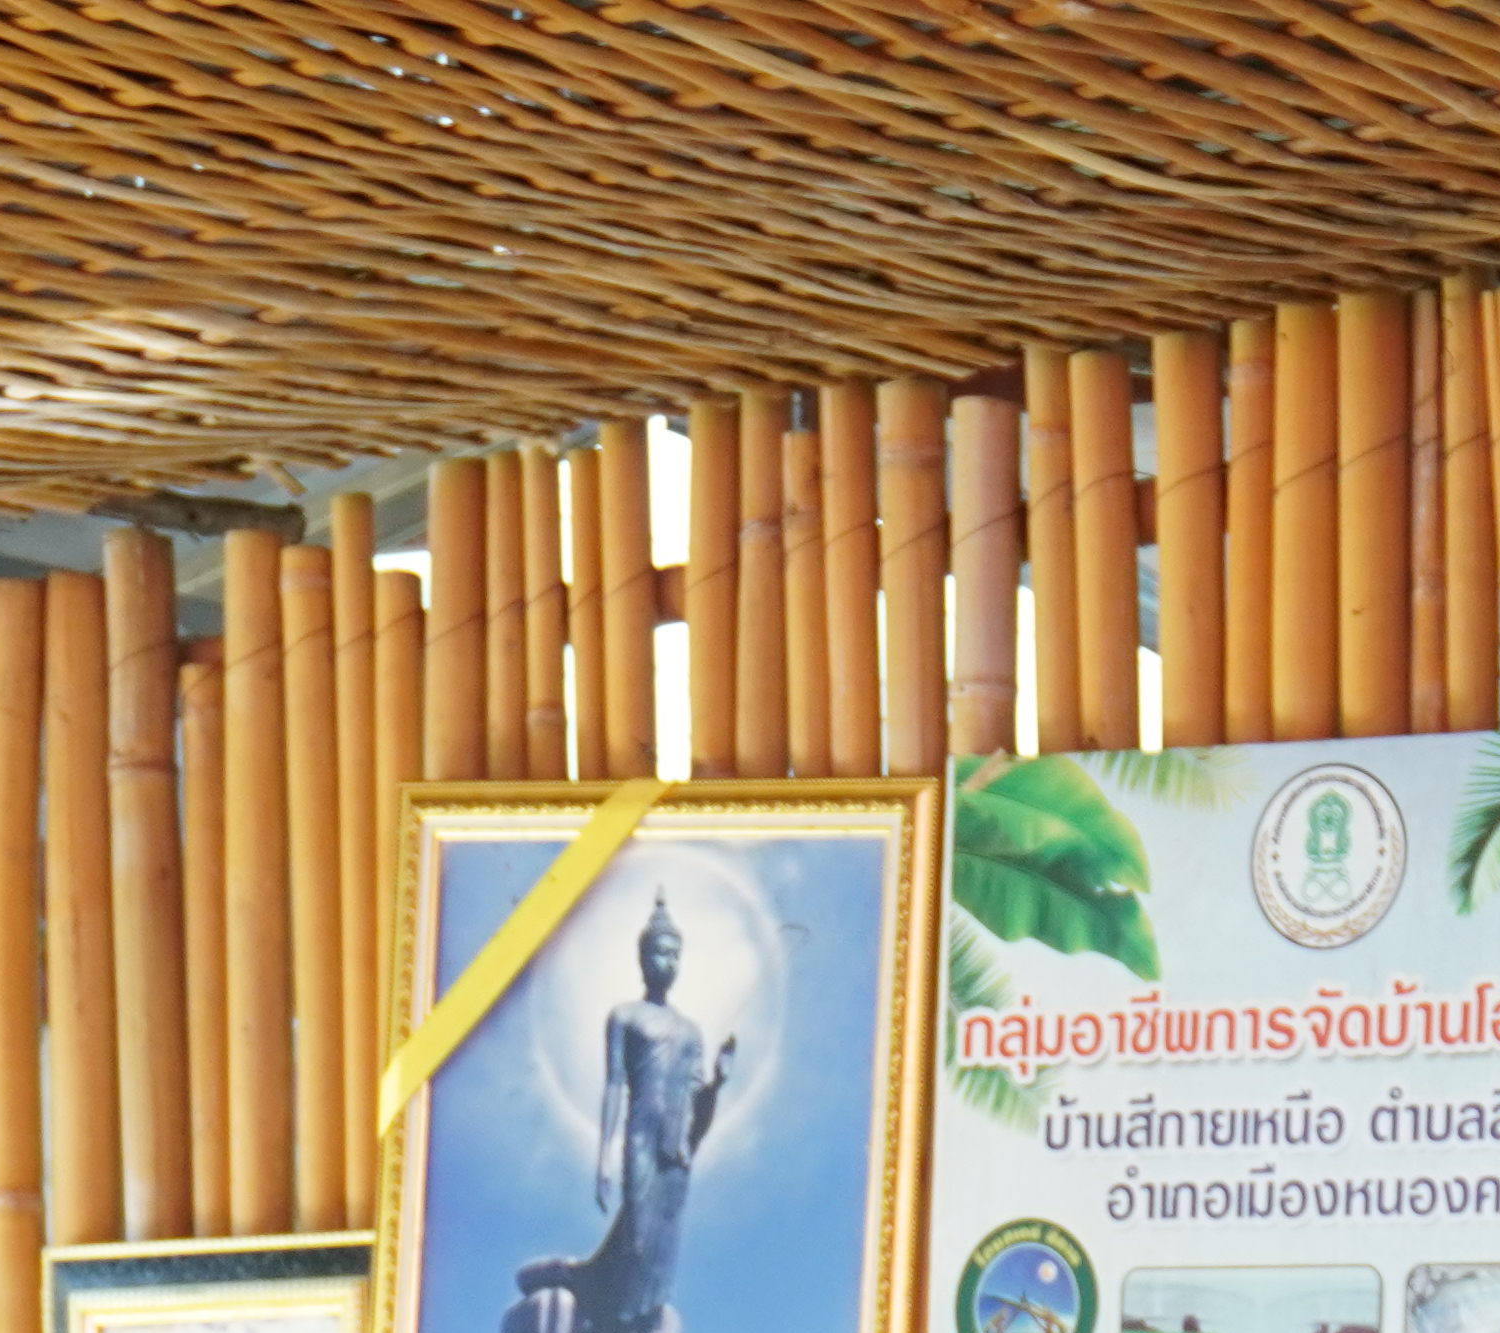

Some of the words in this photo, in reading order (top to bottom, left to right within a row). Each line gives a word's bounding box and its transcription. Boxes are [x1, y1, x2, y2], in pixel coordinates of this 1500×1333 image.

[1044, 1090, 1345, 1152] บ้านสีกายเหนือ
